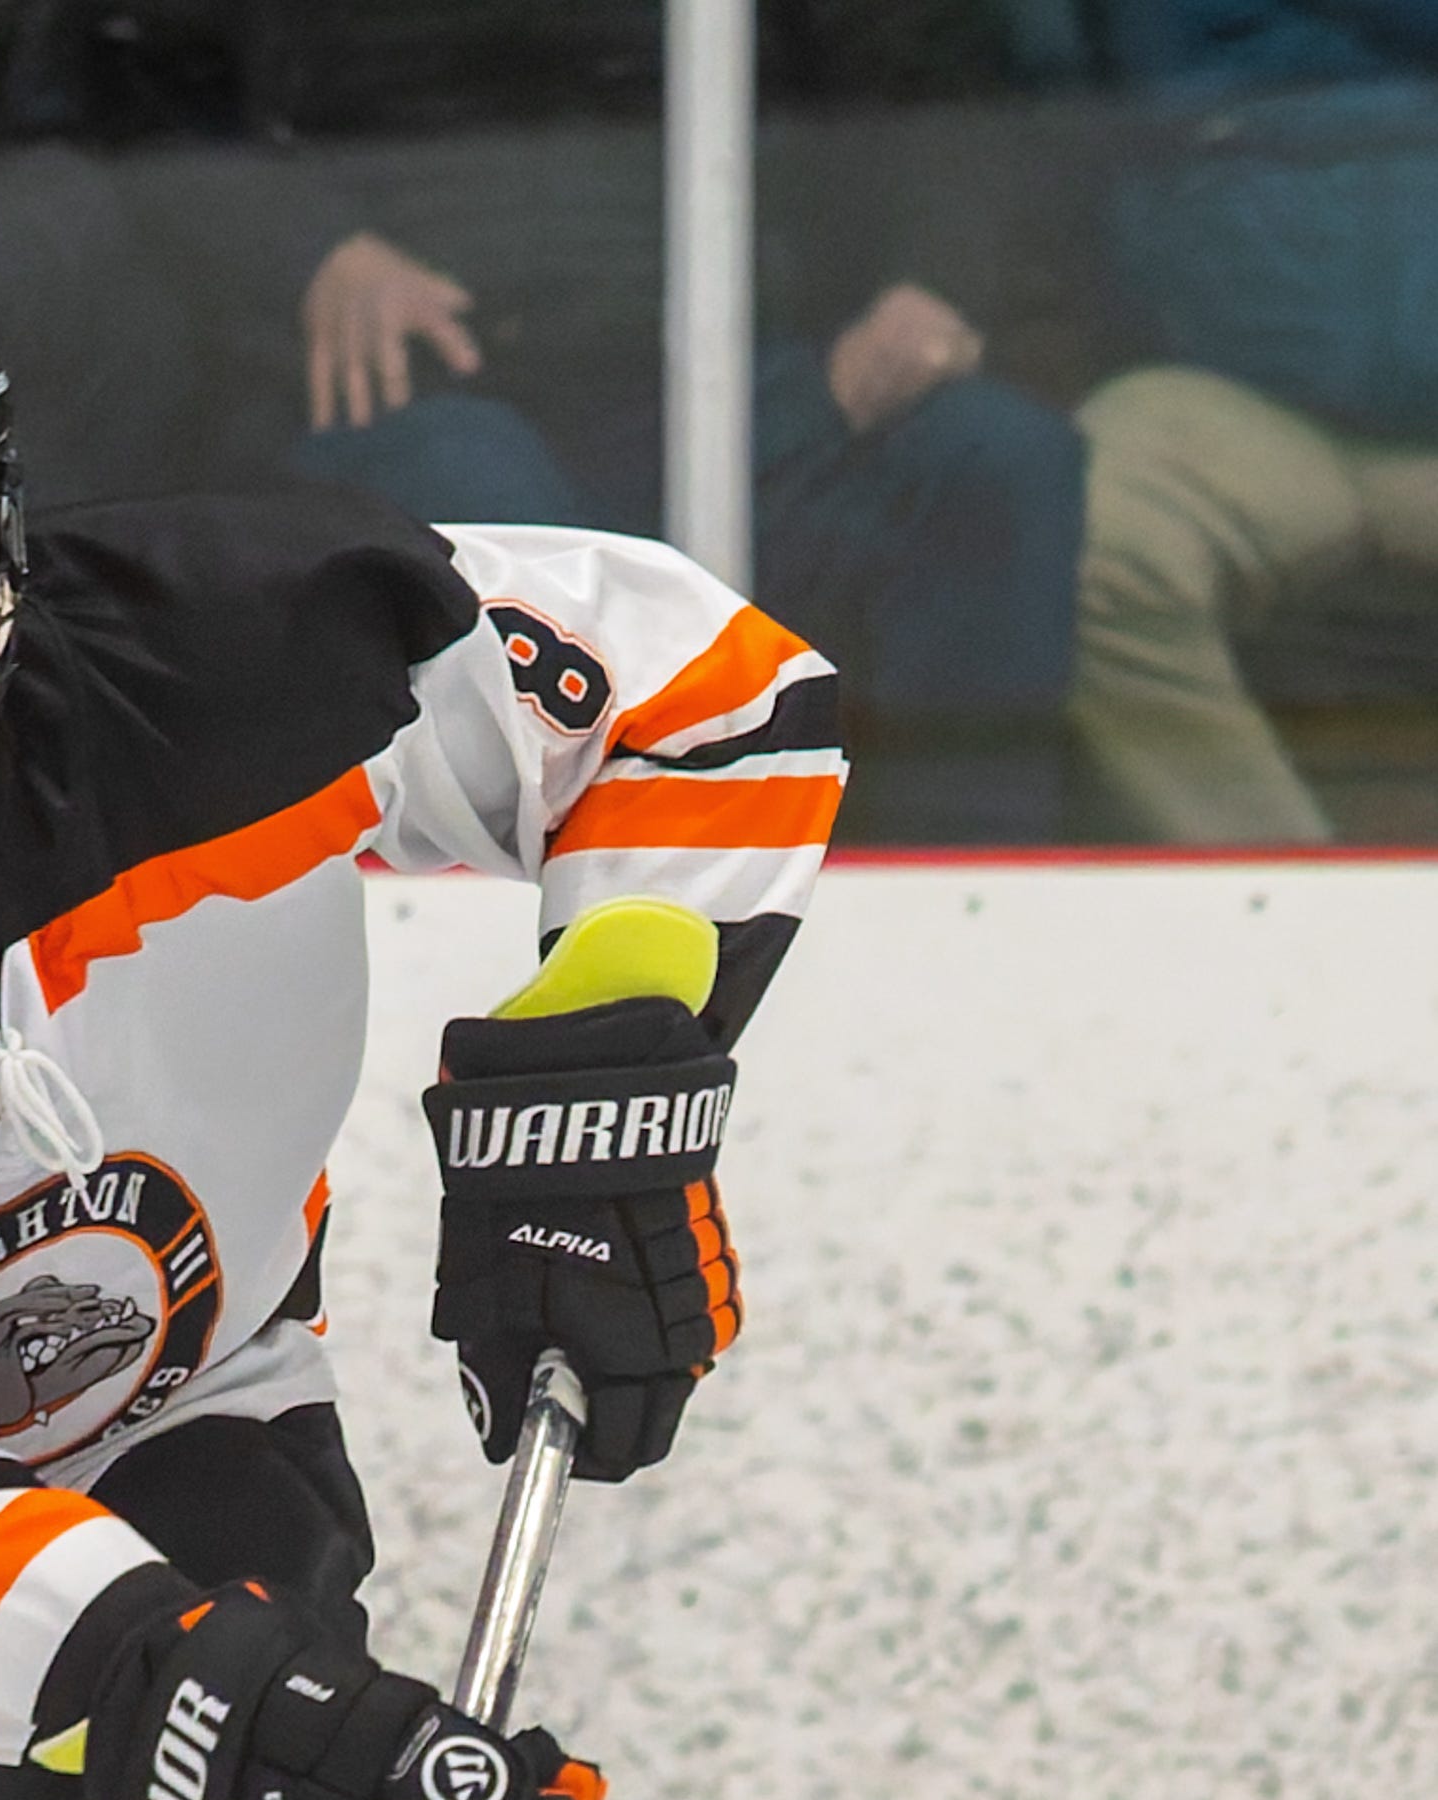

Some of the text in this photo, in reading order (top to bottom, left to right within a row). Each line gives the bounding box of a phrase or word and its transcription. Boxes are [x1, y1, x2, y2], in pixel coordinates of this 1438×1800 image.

[480, 599, 616, 737] 8
[448, 1083, 731, 1168] WARRIOR
[508, 1223, 611, 1262] ALPHA
